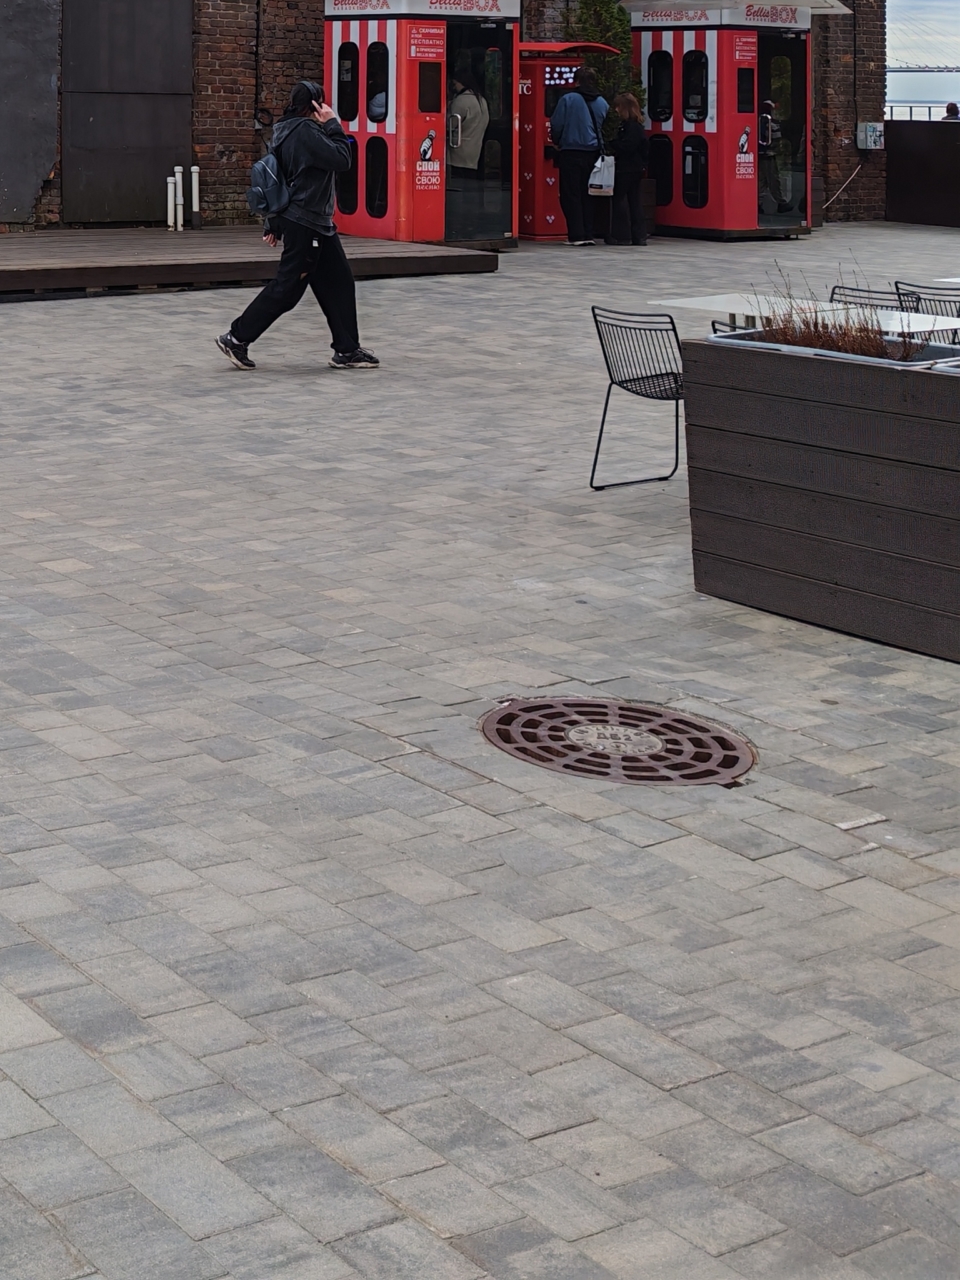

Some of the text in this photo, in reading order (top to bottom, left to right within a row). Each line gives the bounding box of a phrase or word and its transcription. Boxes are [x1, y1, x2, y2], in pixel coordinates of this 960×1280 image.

[745, 4, 799, 23] Bellis BOX
[416, 159, 441, 172] СПОЙ
[415, 176, 441, 185] СВОЮ
